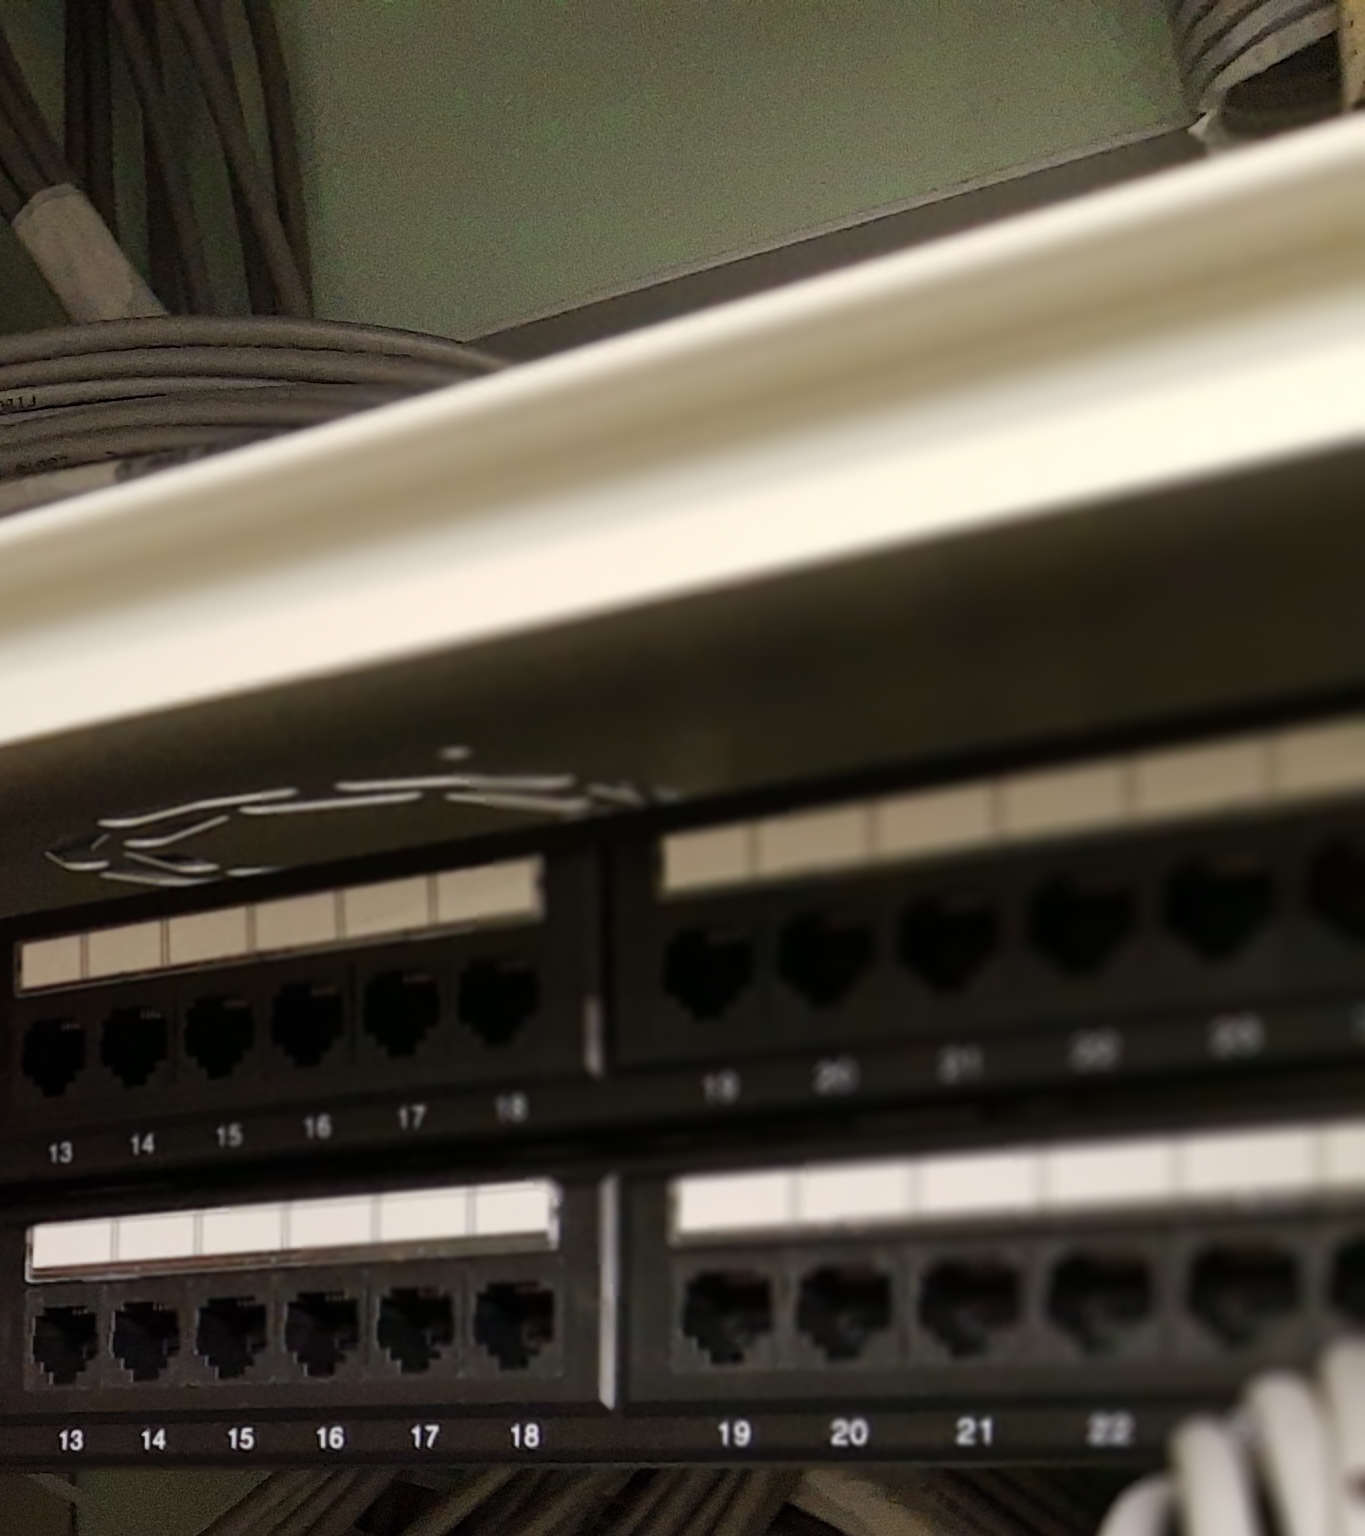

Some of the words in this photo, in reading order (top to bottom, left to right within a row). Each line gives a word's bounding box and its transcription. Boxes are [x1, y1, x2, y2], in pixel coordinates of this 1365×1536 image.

[49, 1141, 73, 1164] 13
[131, 1133, 155, 1155] 14
[216, 1123, 243, 1147] 15
[305, 1114, 332, 1138] 16
[399, 1104, 426, 1128] 17
[59, 1429, 84, 1451] 13
[141, 1428, 166, 1451] 14
[228, 1427, 255, 1450] 15
[316, 1425, 344, 1449] 16
[411, 1424, 440, 1448] 17
[510, 1423, 540, 1448] 18
[718, 1420, 752, 1447] 19
[830, 1418, 869, 1446] 20
[956, 1416, 993, 1445] 21
